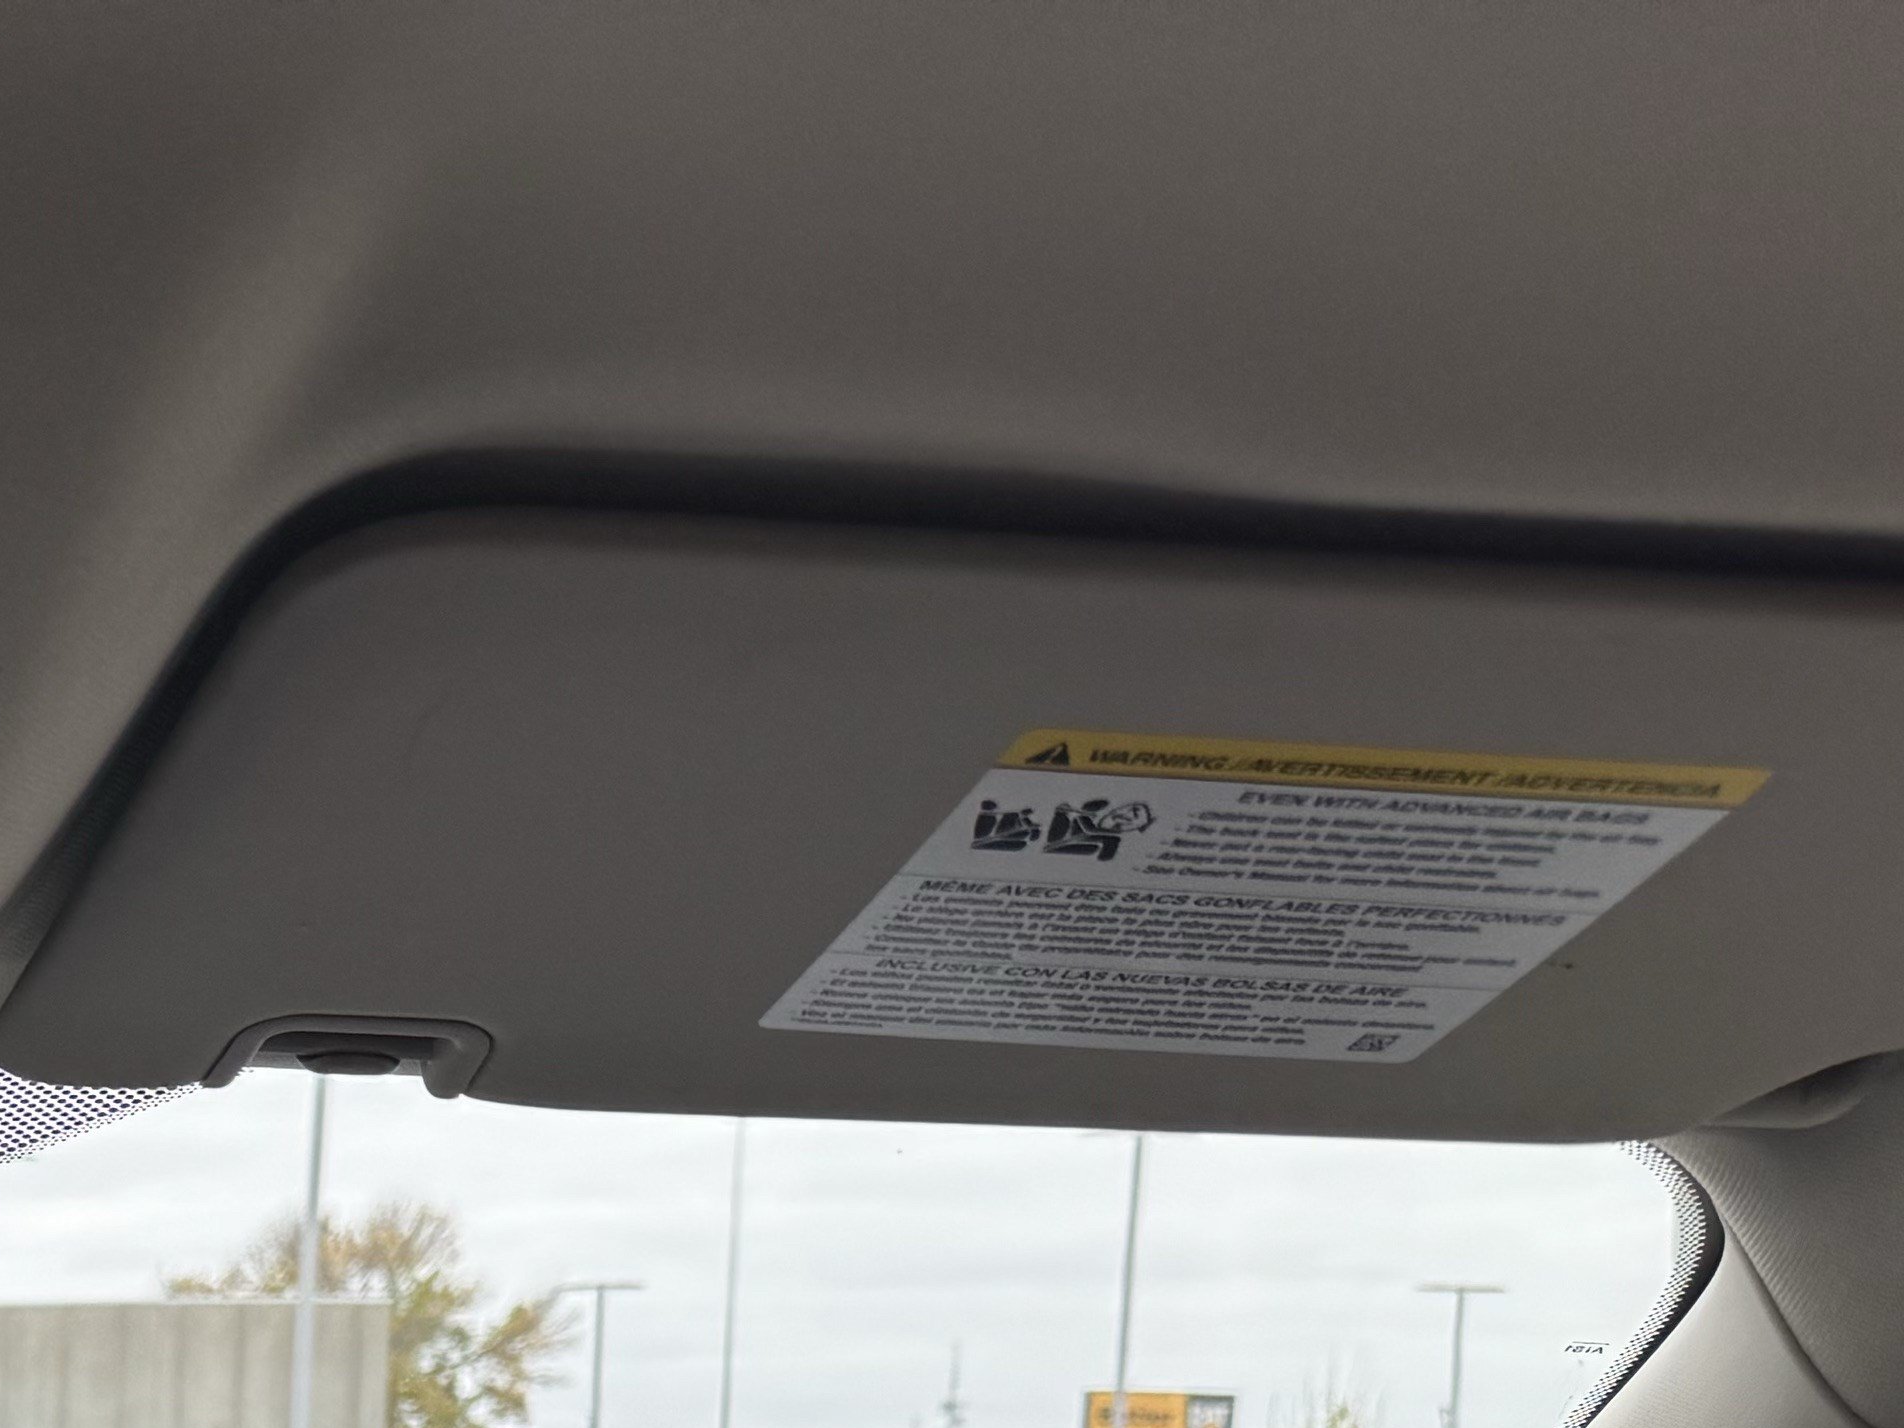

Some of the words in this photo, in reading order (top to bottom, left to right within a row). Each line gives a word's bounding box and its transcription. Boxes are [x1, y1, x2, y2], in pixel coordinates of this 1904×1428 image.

[1239, 790, 1306, 806] EVEN
[1311, 794, 1379, 809] WITH
[1380, 799, 1523, 818] ADVANCED
[1523, 807, 1573, 820] AIR
[1573, 809, 1650, 825] BAGS
[919, 877, 993, 895] MÊME
[999, 883, 1062, 899] AVEC
[1067, 887, 1120, 902] DES
[1122, 891, 1190, 907] SACS
[1193, 896, 1360, 917] GONFLABLES
[1363, 903, 1569, 926] PERFECTIONNÉS
[876, 958, 1002, 975] INCLUSIVE
[1004, 966, 1058, 980] CON
[1059, 969, 1110, 982] LAS
[1112, 972, 1207, 989] NUEVAS
[1209, 976, 1313, 993] BOLSAS
[1314, 982, 1354, 995] DE
[1355, 985, 1409, 999] AIRE
